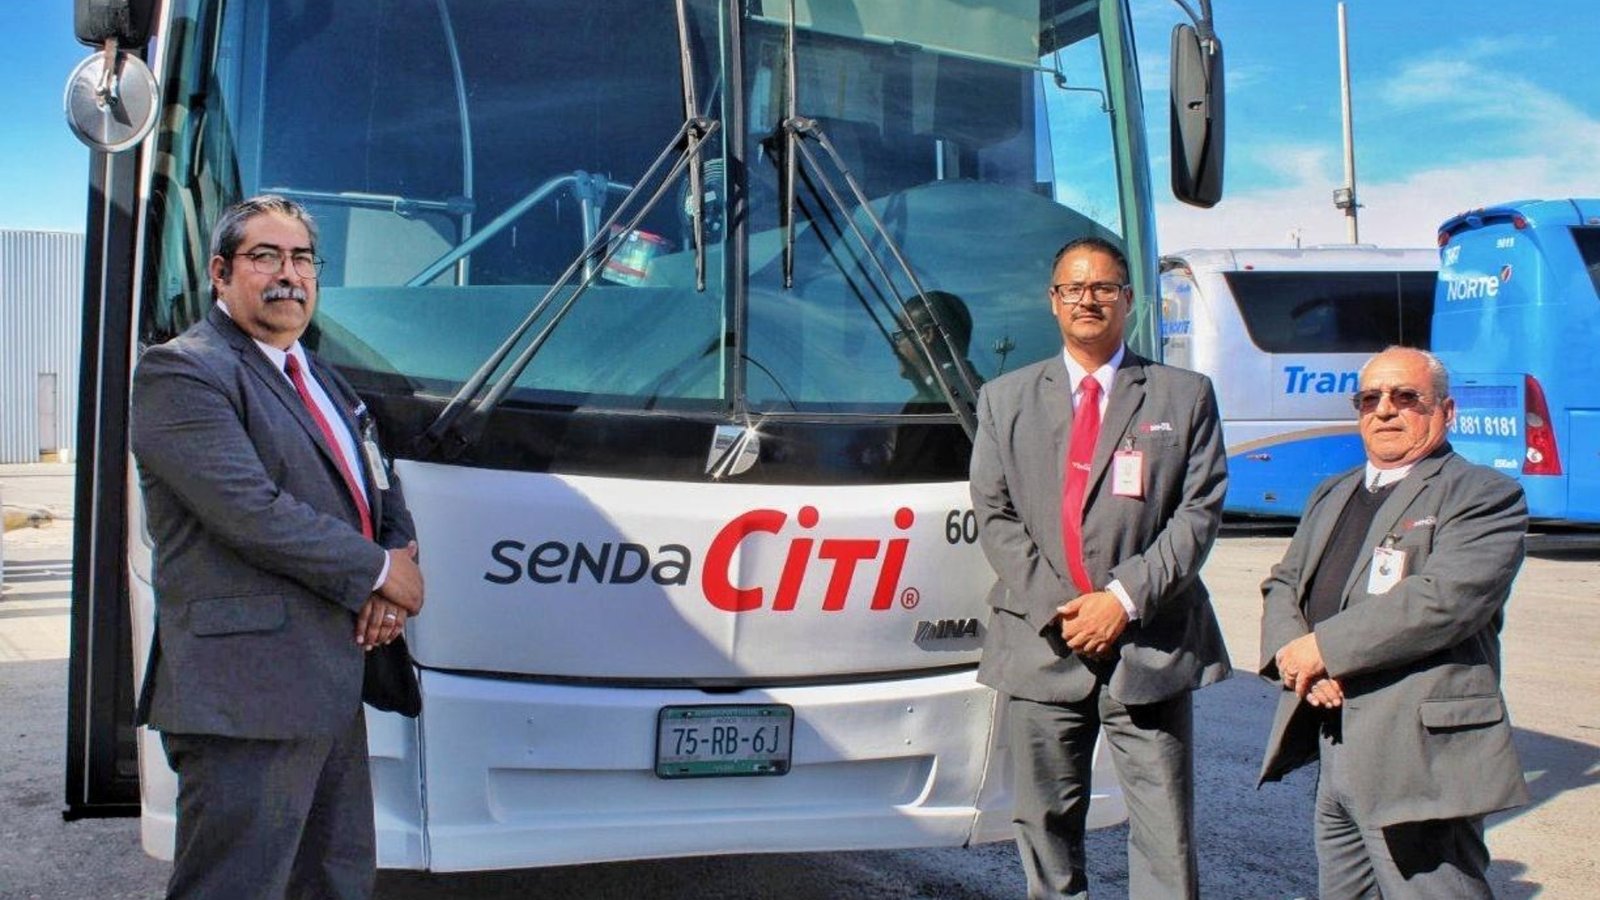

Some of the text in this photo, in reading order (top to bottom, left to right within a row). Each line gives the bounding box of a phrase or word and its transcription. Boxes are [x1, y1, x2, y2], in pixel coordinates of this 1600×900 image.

[1284, 366, 1359, 394] Tran
[1459, 415, 1481, 435] 881
[1484, 415, 1517, 437] 8181
[945, 509, 979, 545] 60
[672, 725, 780, 756] 75-RB-6J
